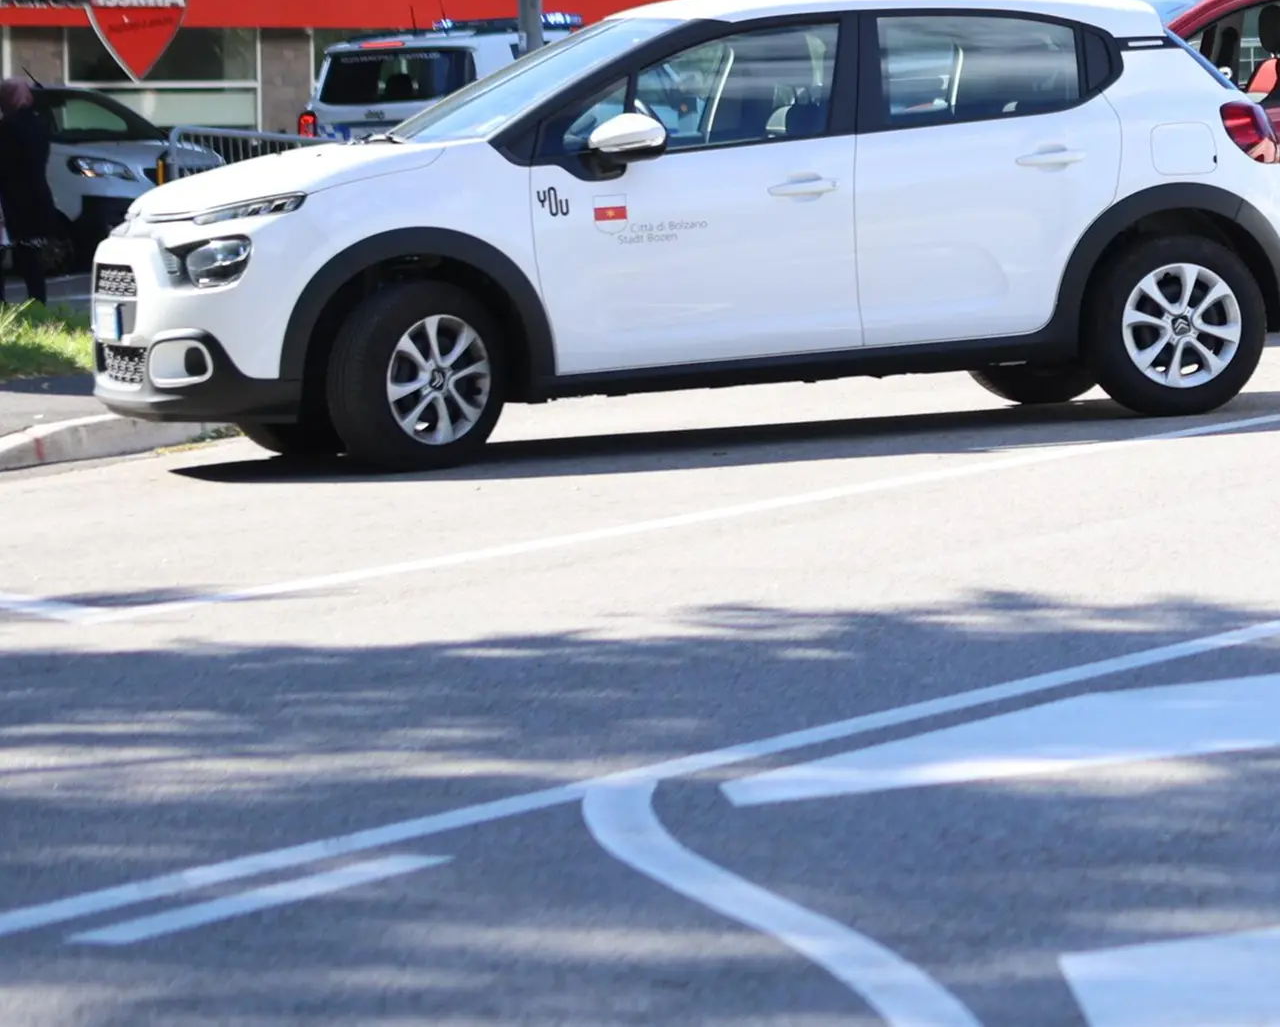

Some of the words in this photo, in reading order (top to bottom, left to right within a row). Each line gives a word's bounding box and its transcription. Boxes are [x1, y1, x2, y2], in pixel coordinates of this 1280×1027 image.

[630, 222, 653, 233] Città
[657, 221, 666, 232] di
[670, 220, 708, 231] Bolzano
[618, 233, 644, 245] Stadt
[648, 232, 678, 243] Bozen
